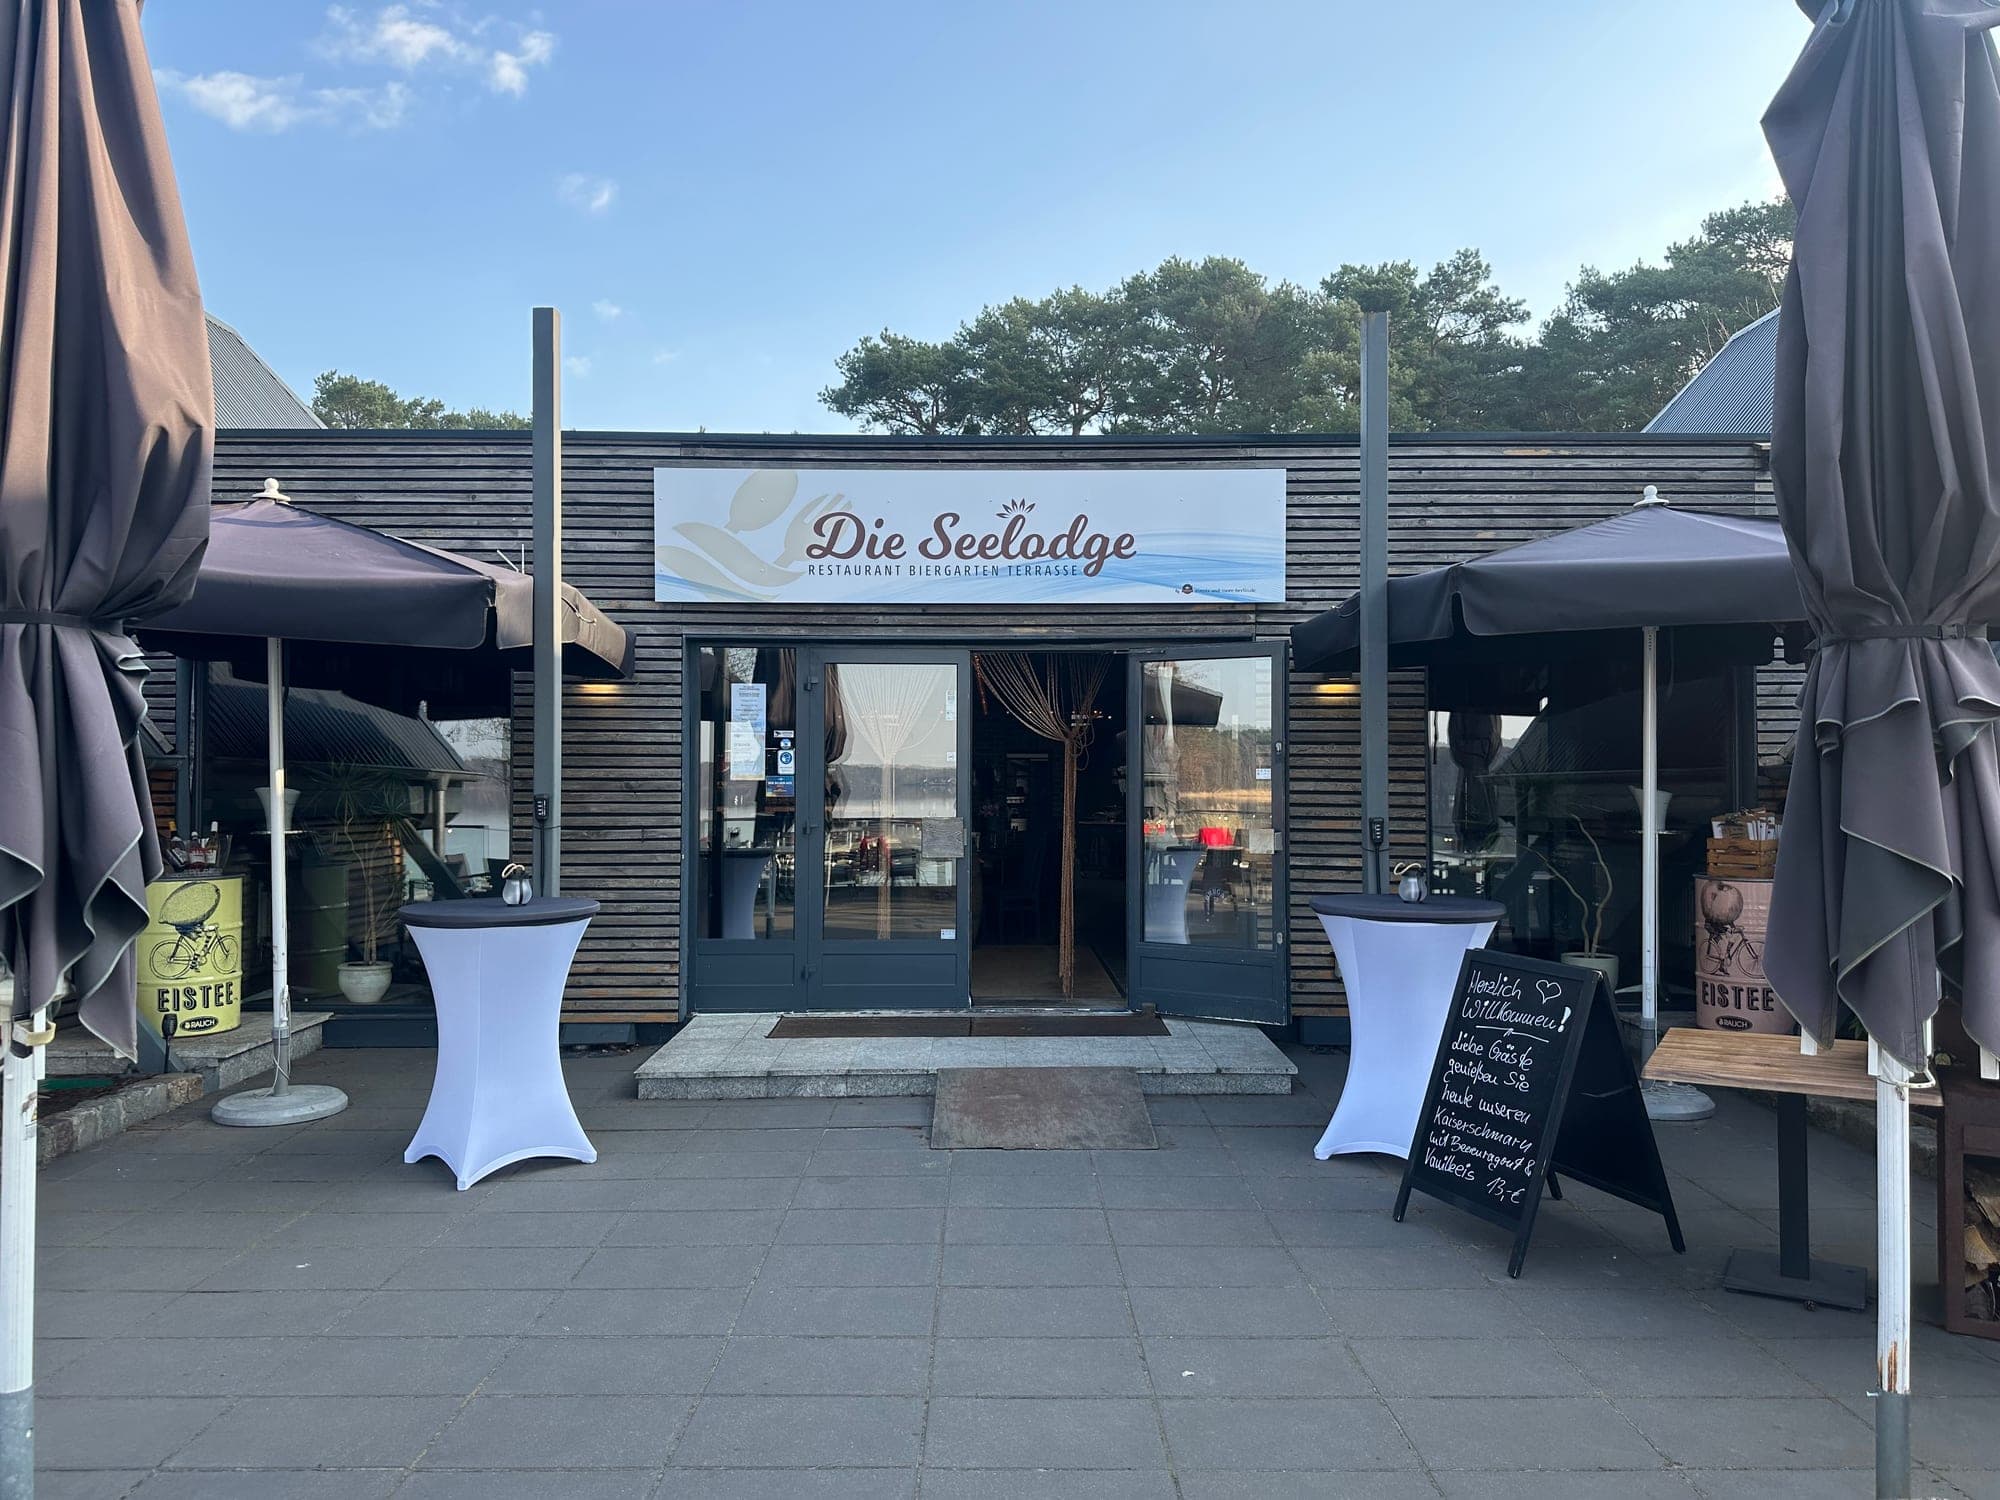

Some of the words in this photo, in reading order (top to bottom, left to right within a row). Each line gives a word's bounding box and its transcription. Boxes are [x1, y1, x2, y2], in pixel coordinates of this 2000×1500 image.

[806, 511, 907, 560] Die
[918, 511, 1137, 578] Seelodge
[808, 564, 901, 577] RESTAURANT
[909, 564, 999, 577] BIERGARTEN
[1007, 564, 1078, 577] TERRASSE
[157, 981, 234, 1012] EISTEE
[1467, 969, 1521, 1000] Herzlich
[1702, 981, 1775, 1012] EISTEE
[190, 1019, 215, 1029] RAUCH
[1461, 996, 1572, 1033] Willkommen!
[1722, 1018, 1748, 1028] RAUCH
[1488, 1039, 1533, 1071] Gäste
[1443, 1058, 1499, 1085] genießen
[1503, 1071, 1530, 1092] Sie
[1441, 1083, 1474, 1109] heute
[1478, 1098, 1531, 1124] unseren
[1429, 1129, 1450, 1147] mit
[1524, 1159, 1536, 1177] &
